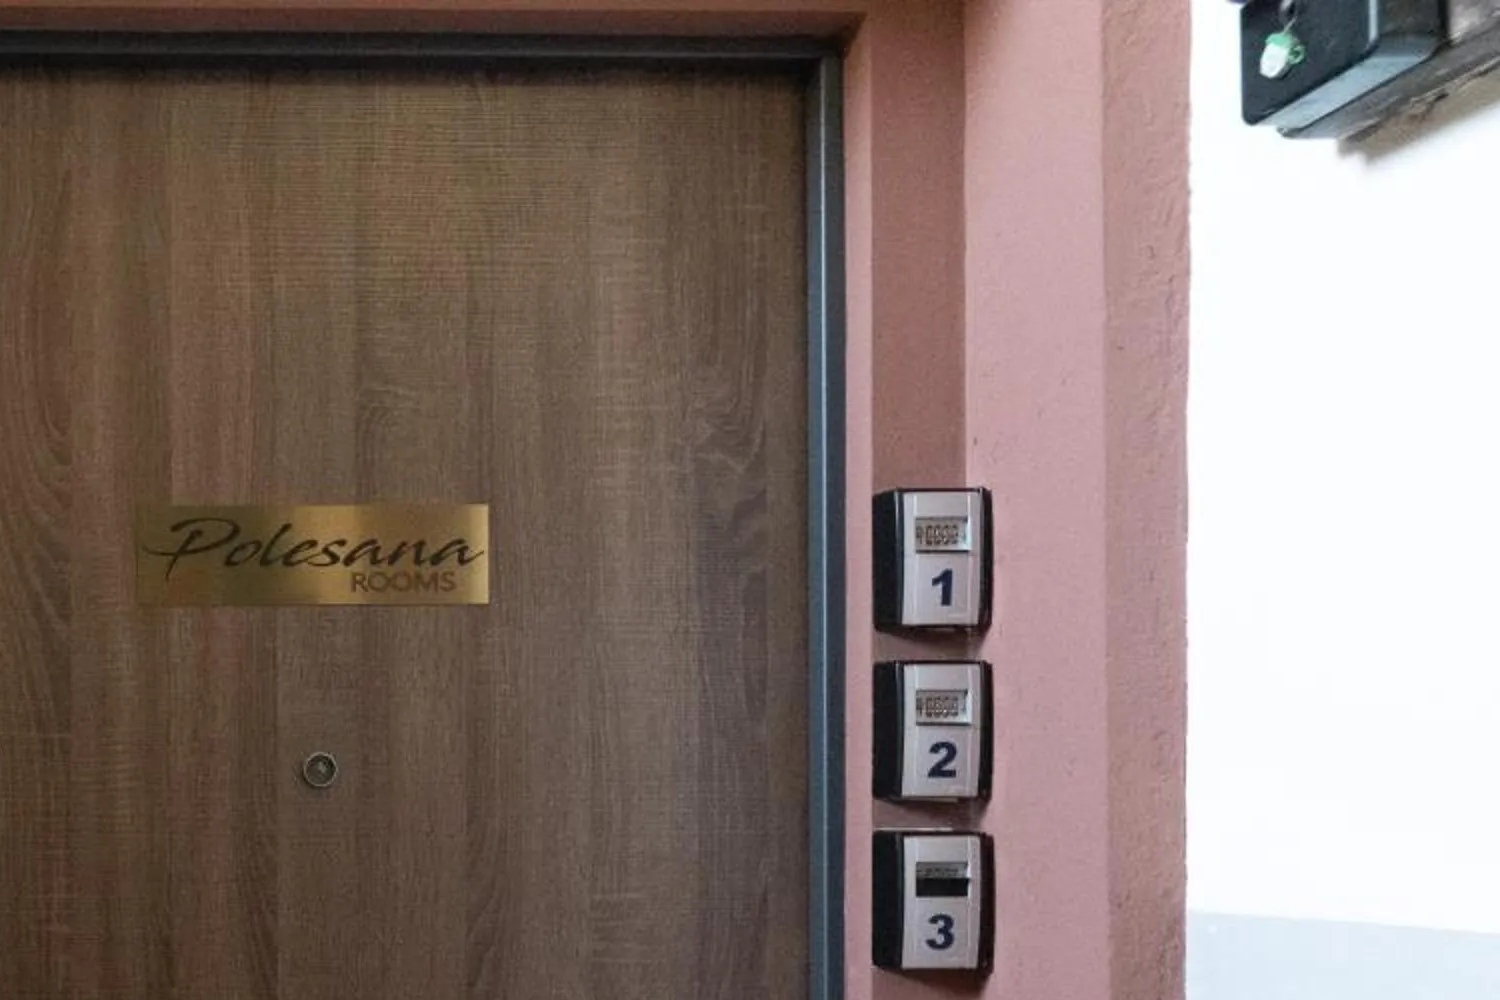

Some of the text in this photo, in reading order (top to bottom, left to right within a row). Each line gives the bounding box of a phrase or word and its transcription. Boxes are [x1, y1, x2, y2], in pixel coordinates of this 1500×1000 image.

[143, 517, 484, 582] Polesana
[351, 571, 457, 593] ROOMS
[931, 568, 953, 607] 1
[927, 741, 957, 779] 2
[925, 913, 955, 951] 3
